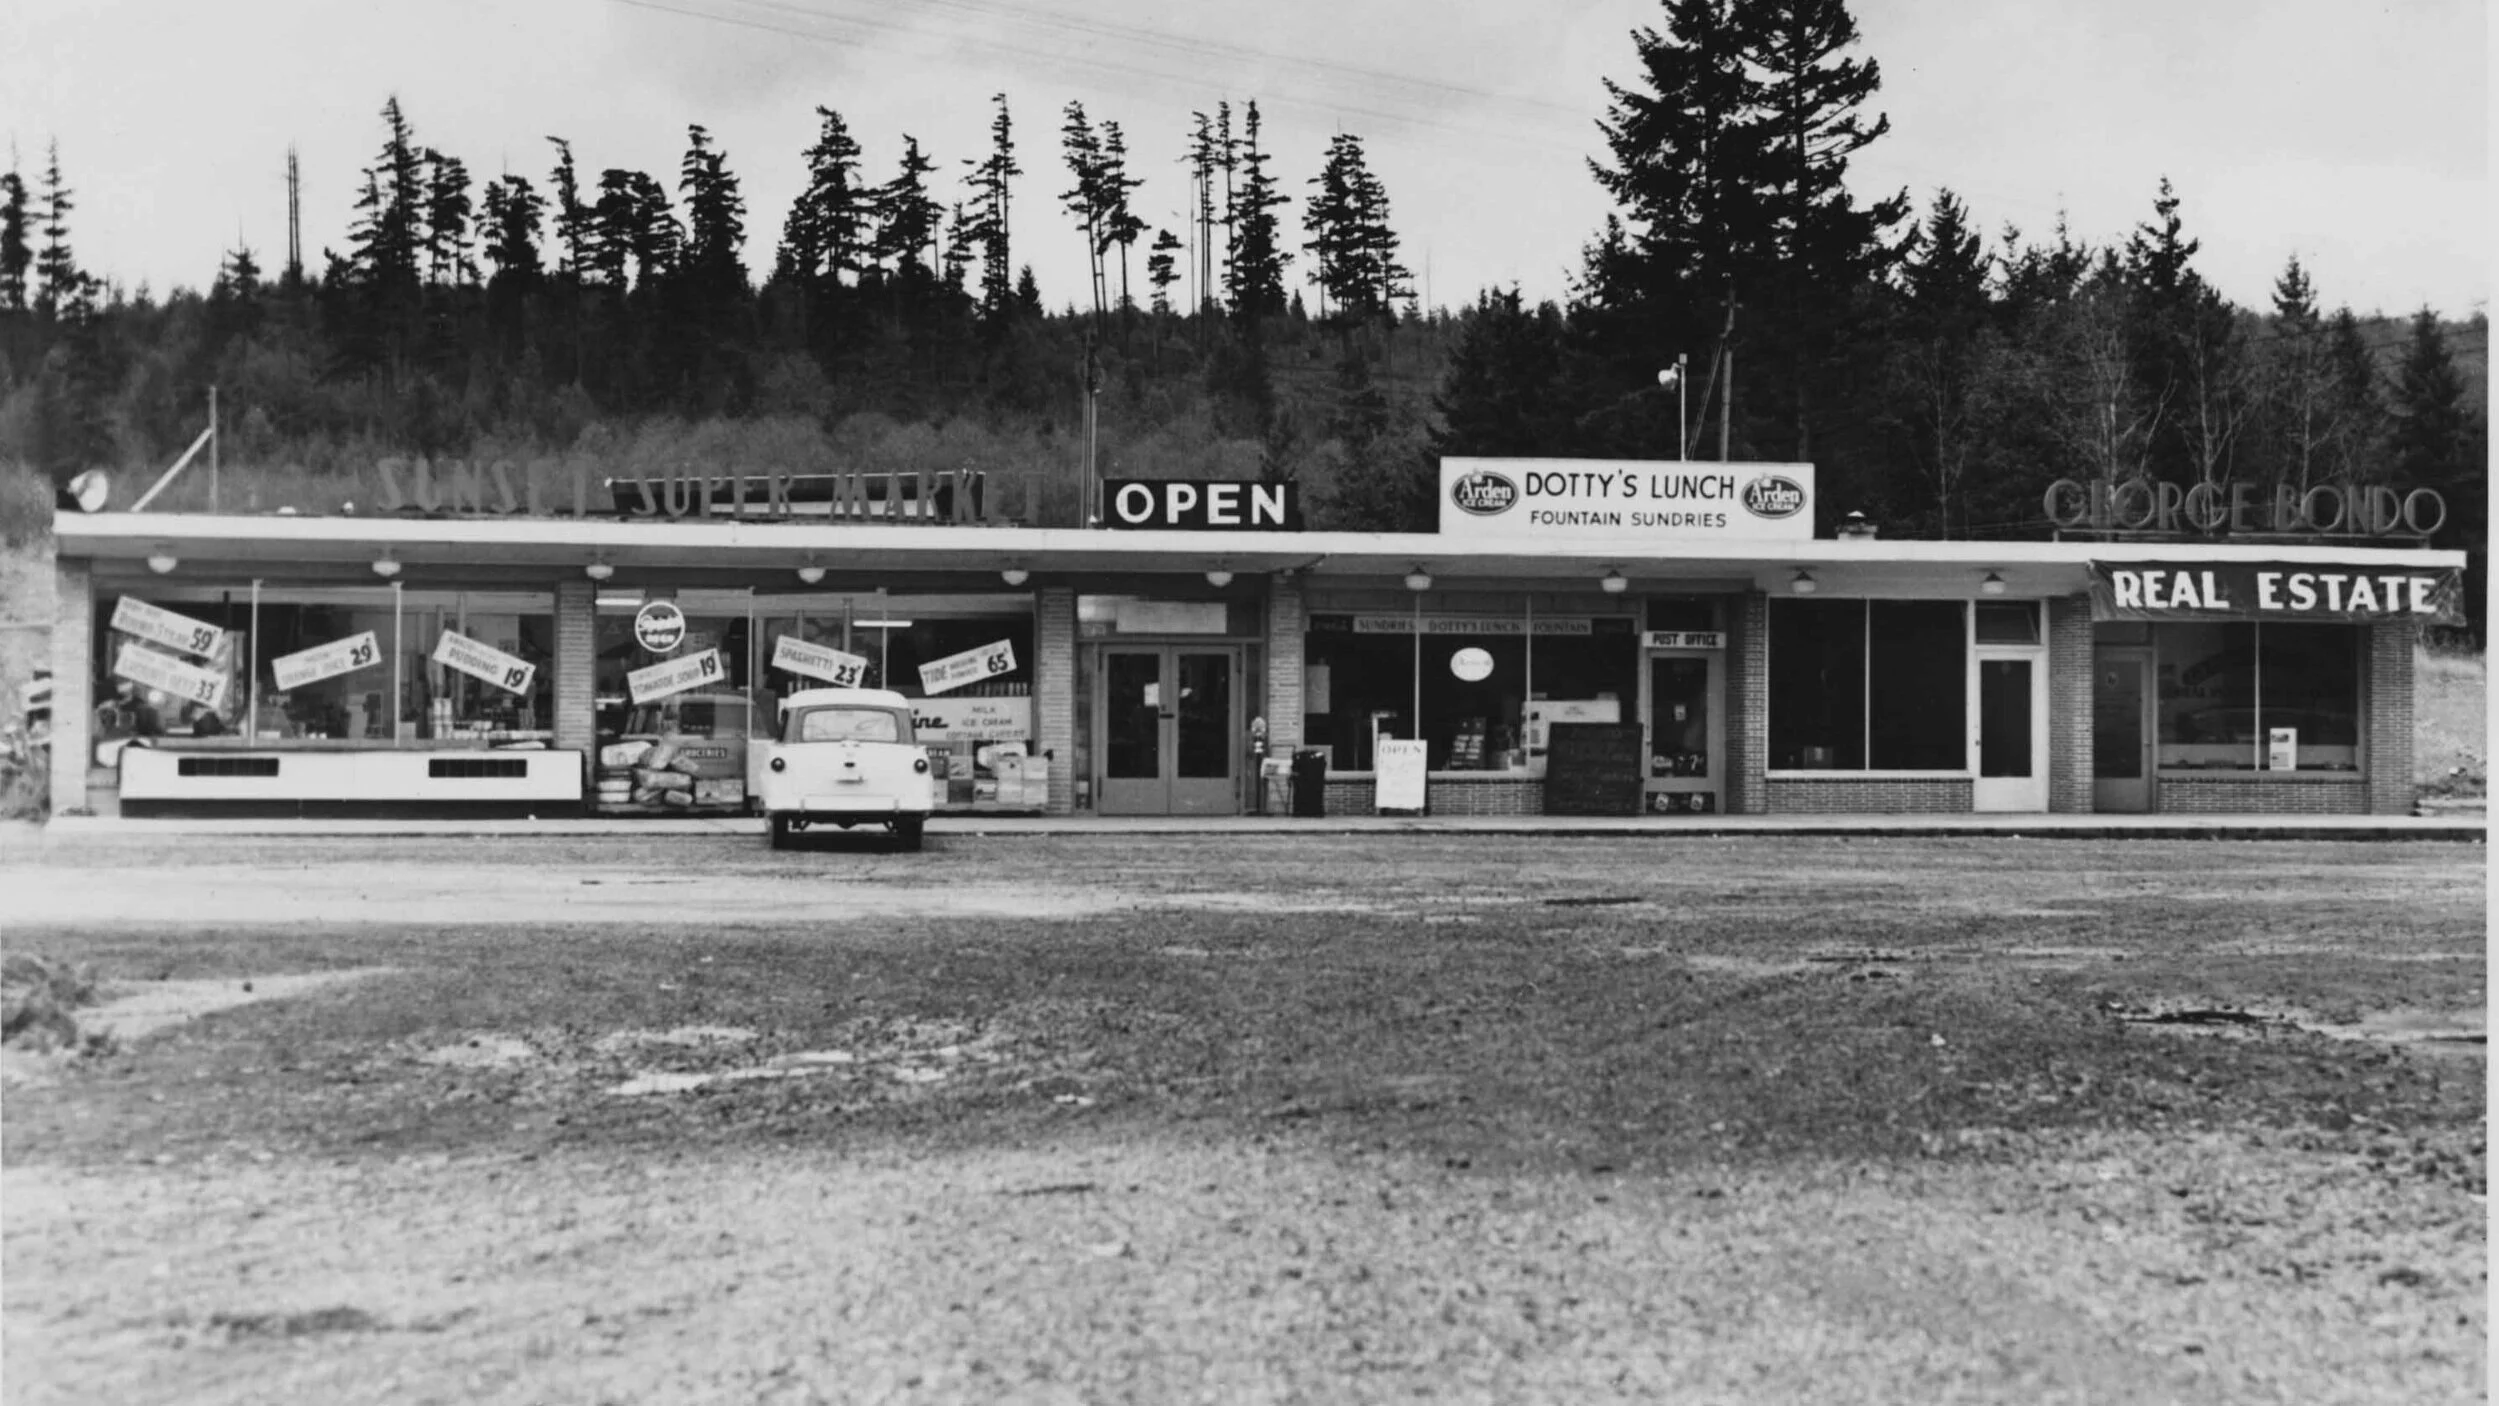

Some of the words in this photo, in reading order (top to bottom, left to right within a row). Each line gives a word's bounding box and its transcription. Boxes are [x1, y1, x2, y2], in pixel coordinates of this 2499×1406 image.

[377, 457, 595, 516] SUNSET
[631, 464, 794, 519] SUPER
[831, 467, 1047, 523] MARKET
[1459, 477, 1512, 501] Arden
[1526, 469, 1637, 498] DOTTY'S
[1651, 475, 1734, 500] LUNCH
[1750, 481, 1801, 504] Arden
[1116, 483, 1284, 525] OPEN
[2044, 478, 2257, 531] GEORGE
[2275, 484, 2446, 534] BONDO
[1531, 510, 1621, 526] FOUNTAIN
[1631, 512, 1727, 528] SUNDRIES
[2113, 571, 2230, 609] REAL
[2257, 572, 2437, 613] ESTATE
[1532, 622, 1590, 633] FOUNTAIN
[1653, 632, 1678, 645] POST
[1685, 634, 1717, 646] OFFICE
